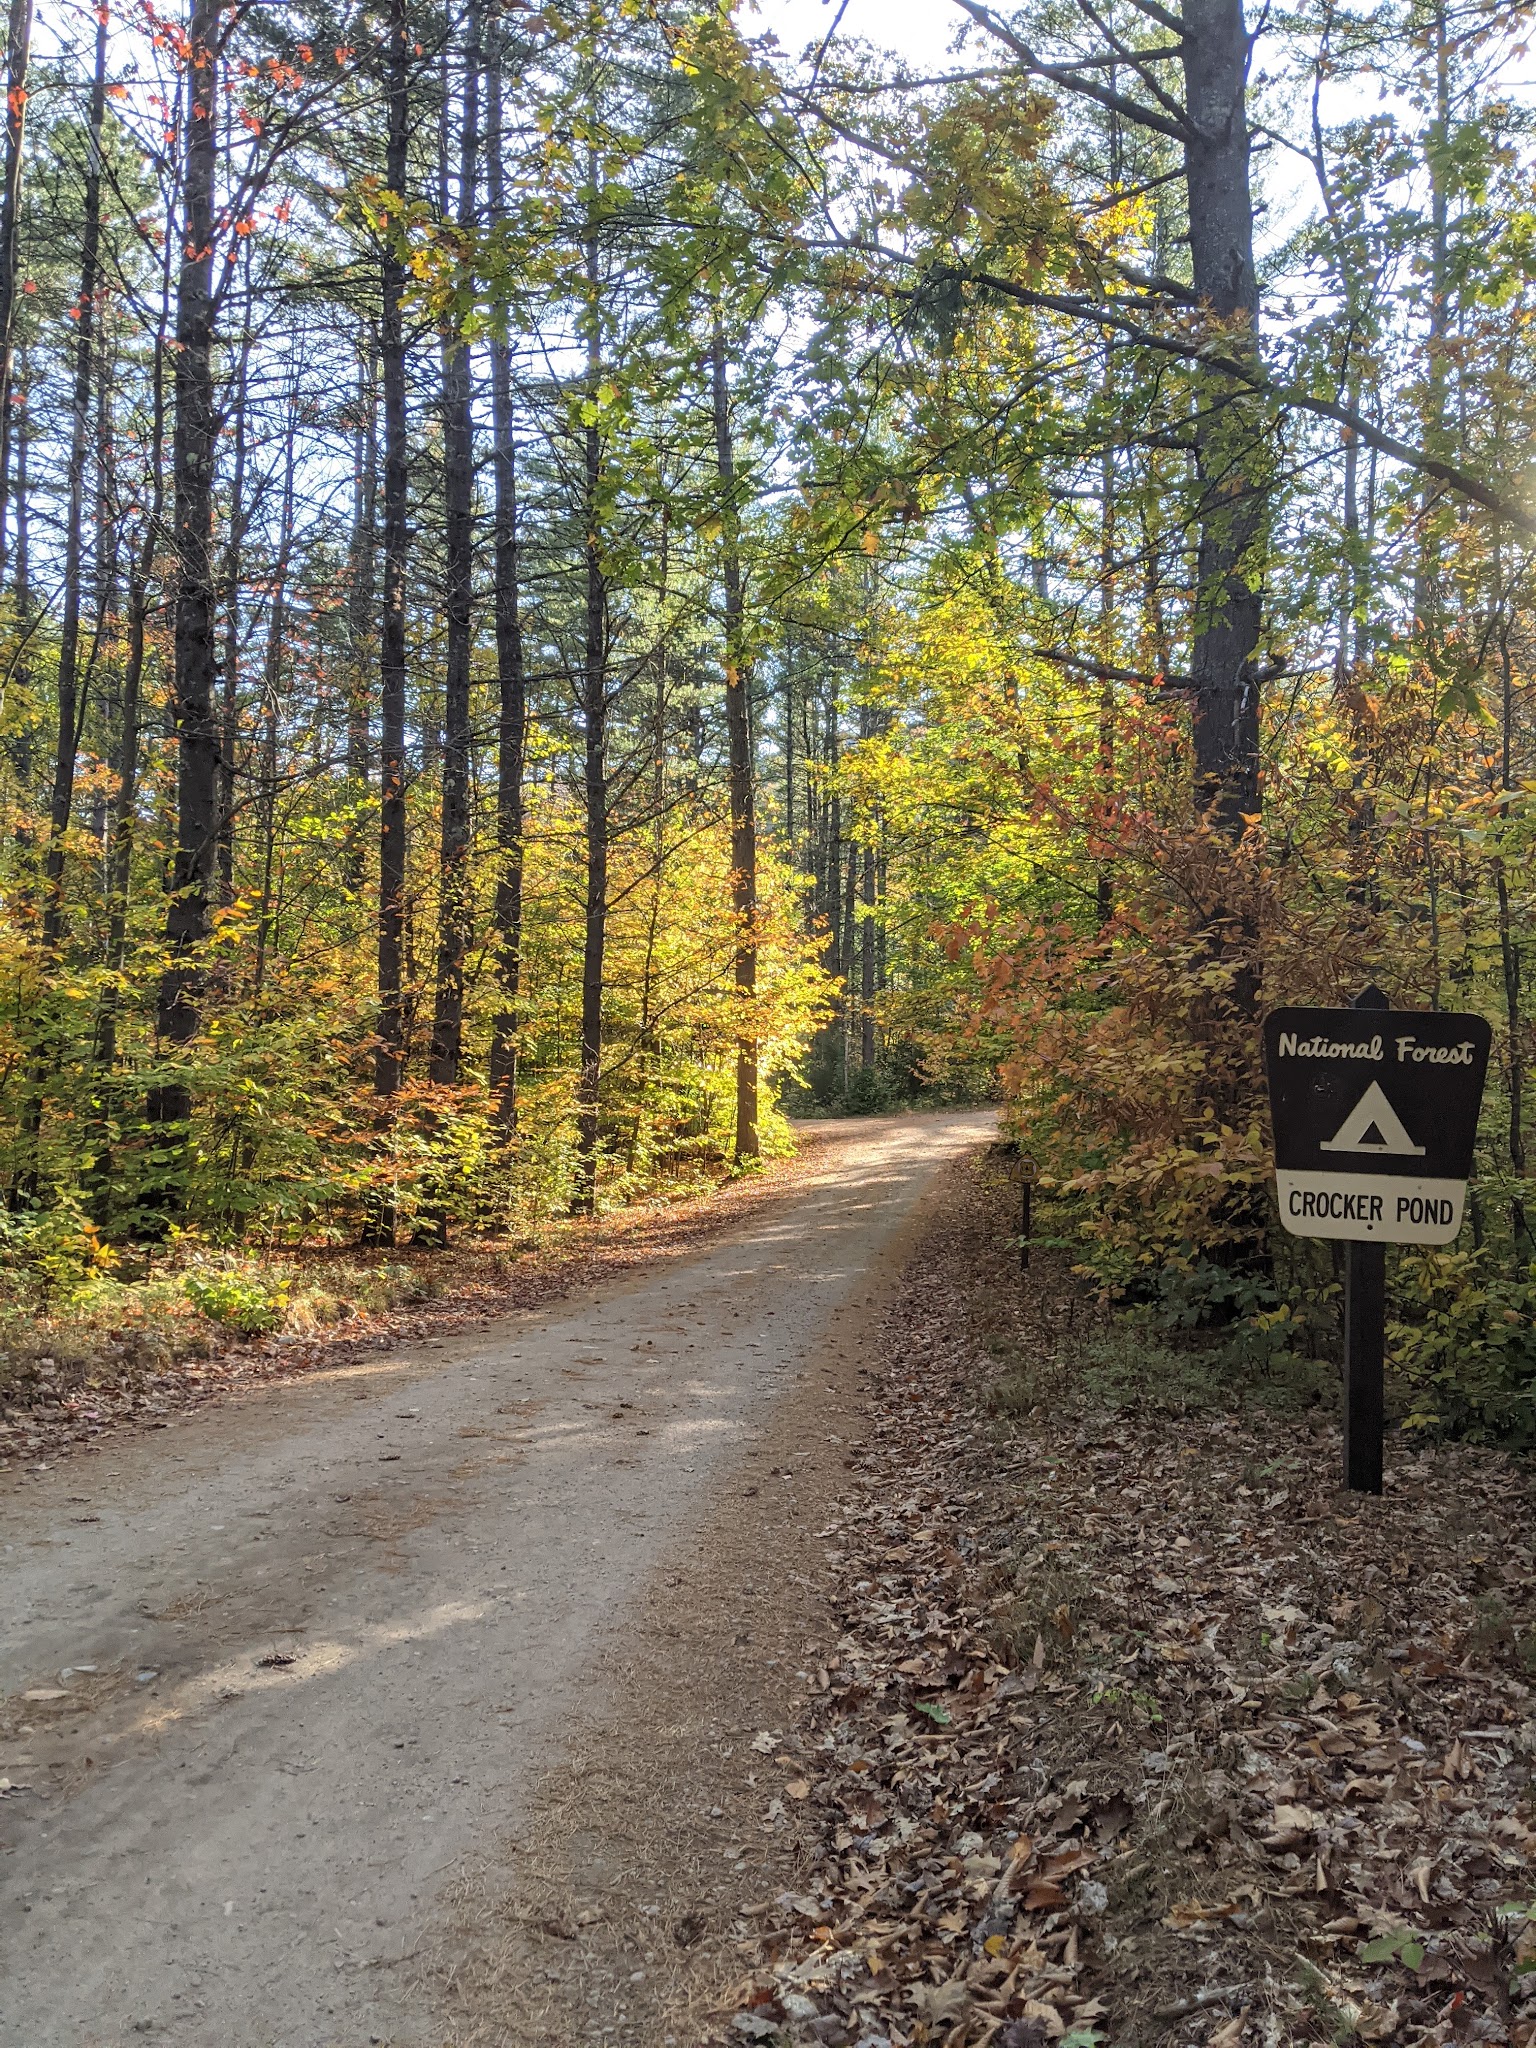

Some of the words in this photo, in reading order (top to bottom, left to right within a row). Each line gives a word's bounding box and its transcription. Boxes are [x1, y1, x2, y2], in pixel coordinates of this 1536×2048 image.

[1279, 1033, 1384, 1061] National
[1394, 1036, 1475, 1064] Forest
[1289, 1190, 1384, 1221] CROCKER
[1396, 1197, 1454, 1225] POND
